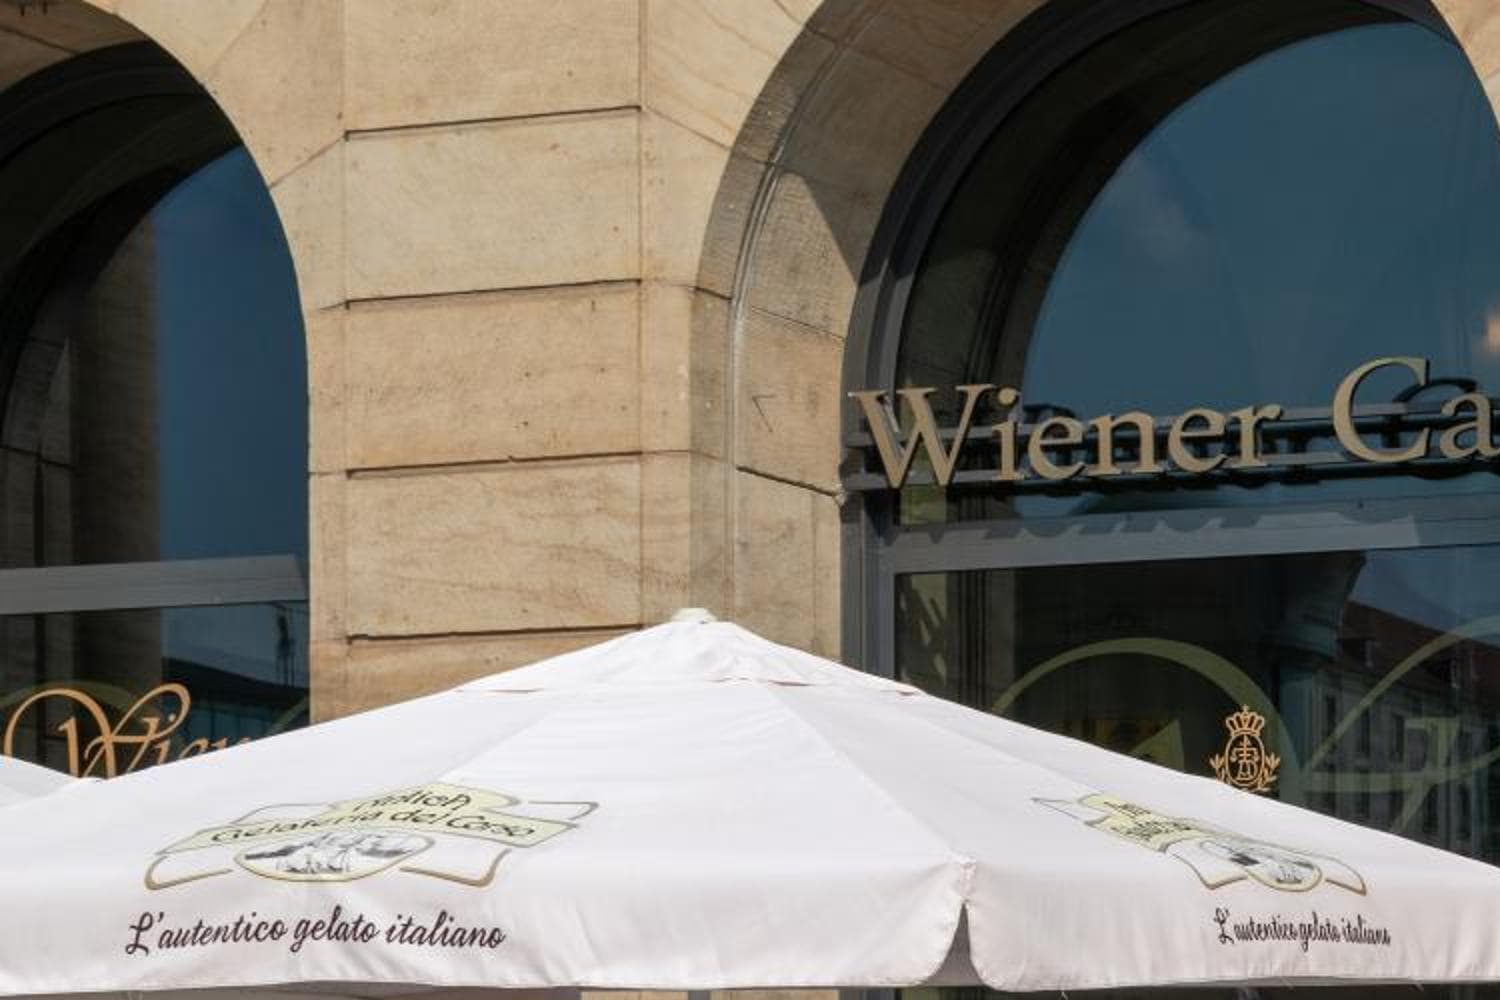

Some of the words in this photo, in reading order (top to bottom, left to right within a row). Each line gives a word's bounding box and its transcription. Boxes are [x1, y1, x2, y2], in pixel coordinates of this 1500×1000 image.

[847, 384, 1283, 488] Wiener
[125, 908, 287, 955] L'autentico
[289, 904, 380, 953] gelato
[385, 909, 506, 950] italiano
[1299, 911, 1341, 953] gelato
[1341, 914, 1391, 945] italiano
